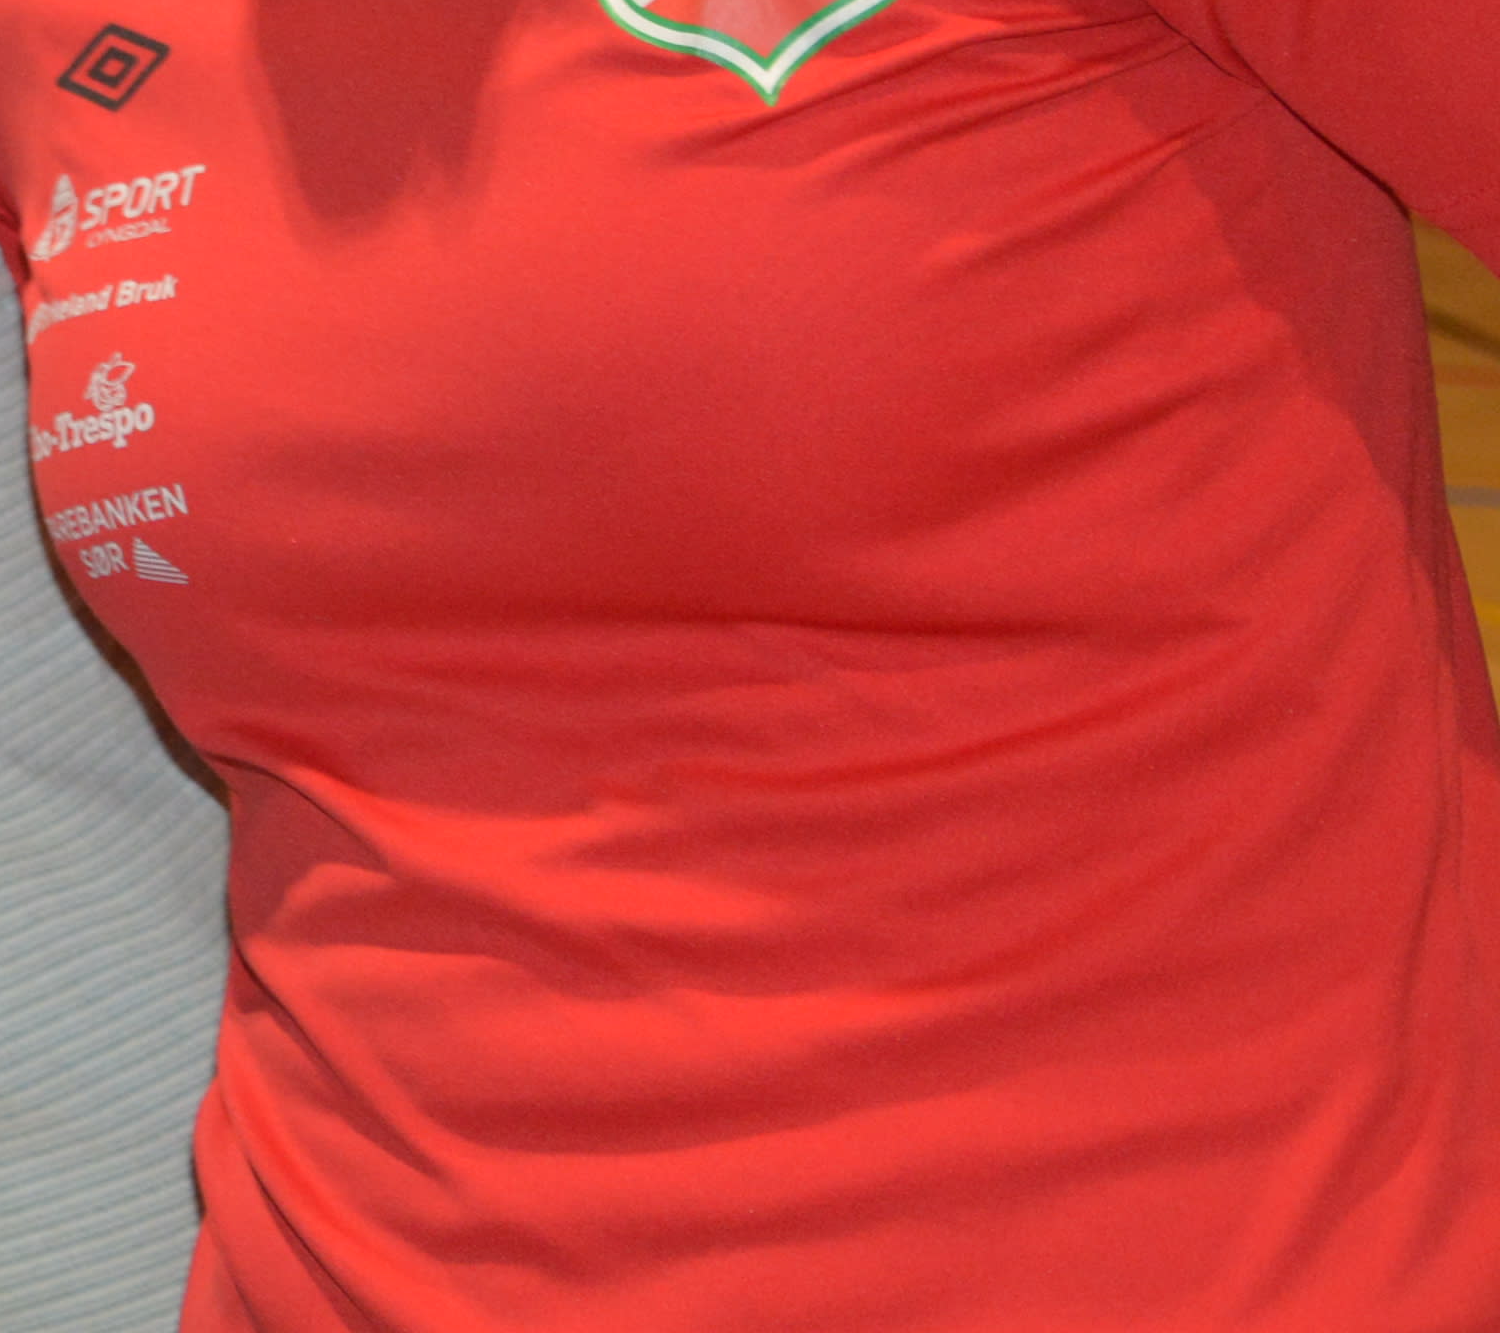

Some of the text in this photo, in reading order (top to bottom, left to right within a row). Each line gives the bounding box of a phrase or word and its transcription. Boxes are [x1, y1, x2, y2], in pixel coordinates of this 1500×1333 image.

[80, 164, 206, 230] SPORT
[115, 273, 179, 308] Bruk
[45, 483, 189, 541] REBANKEN
